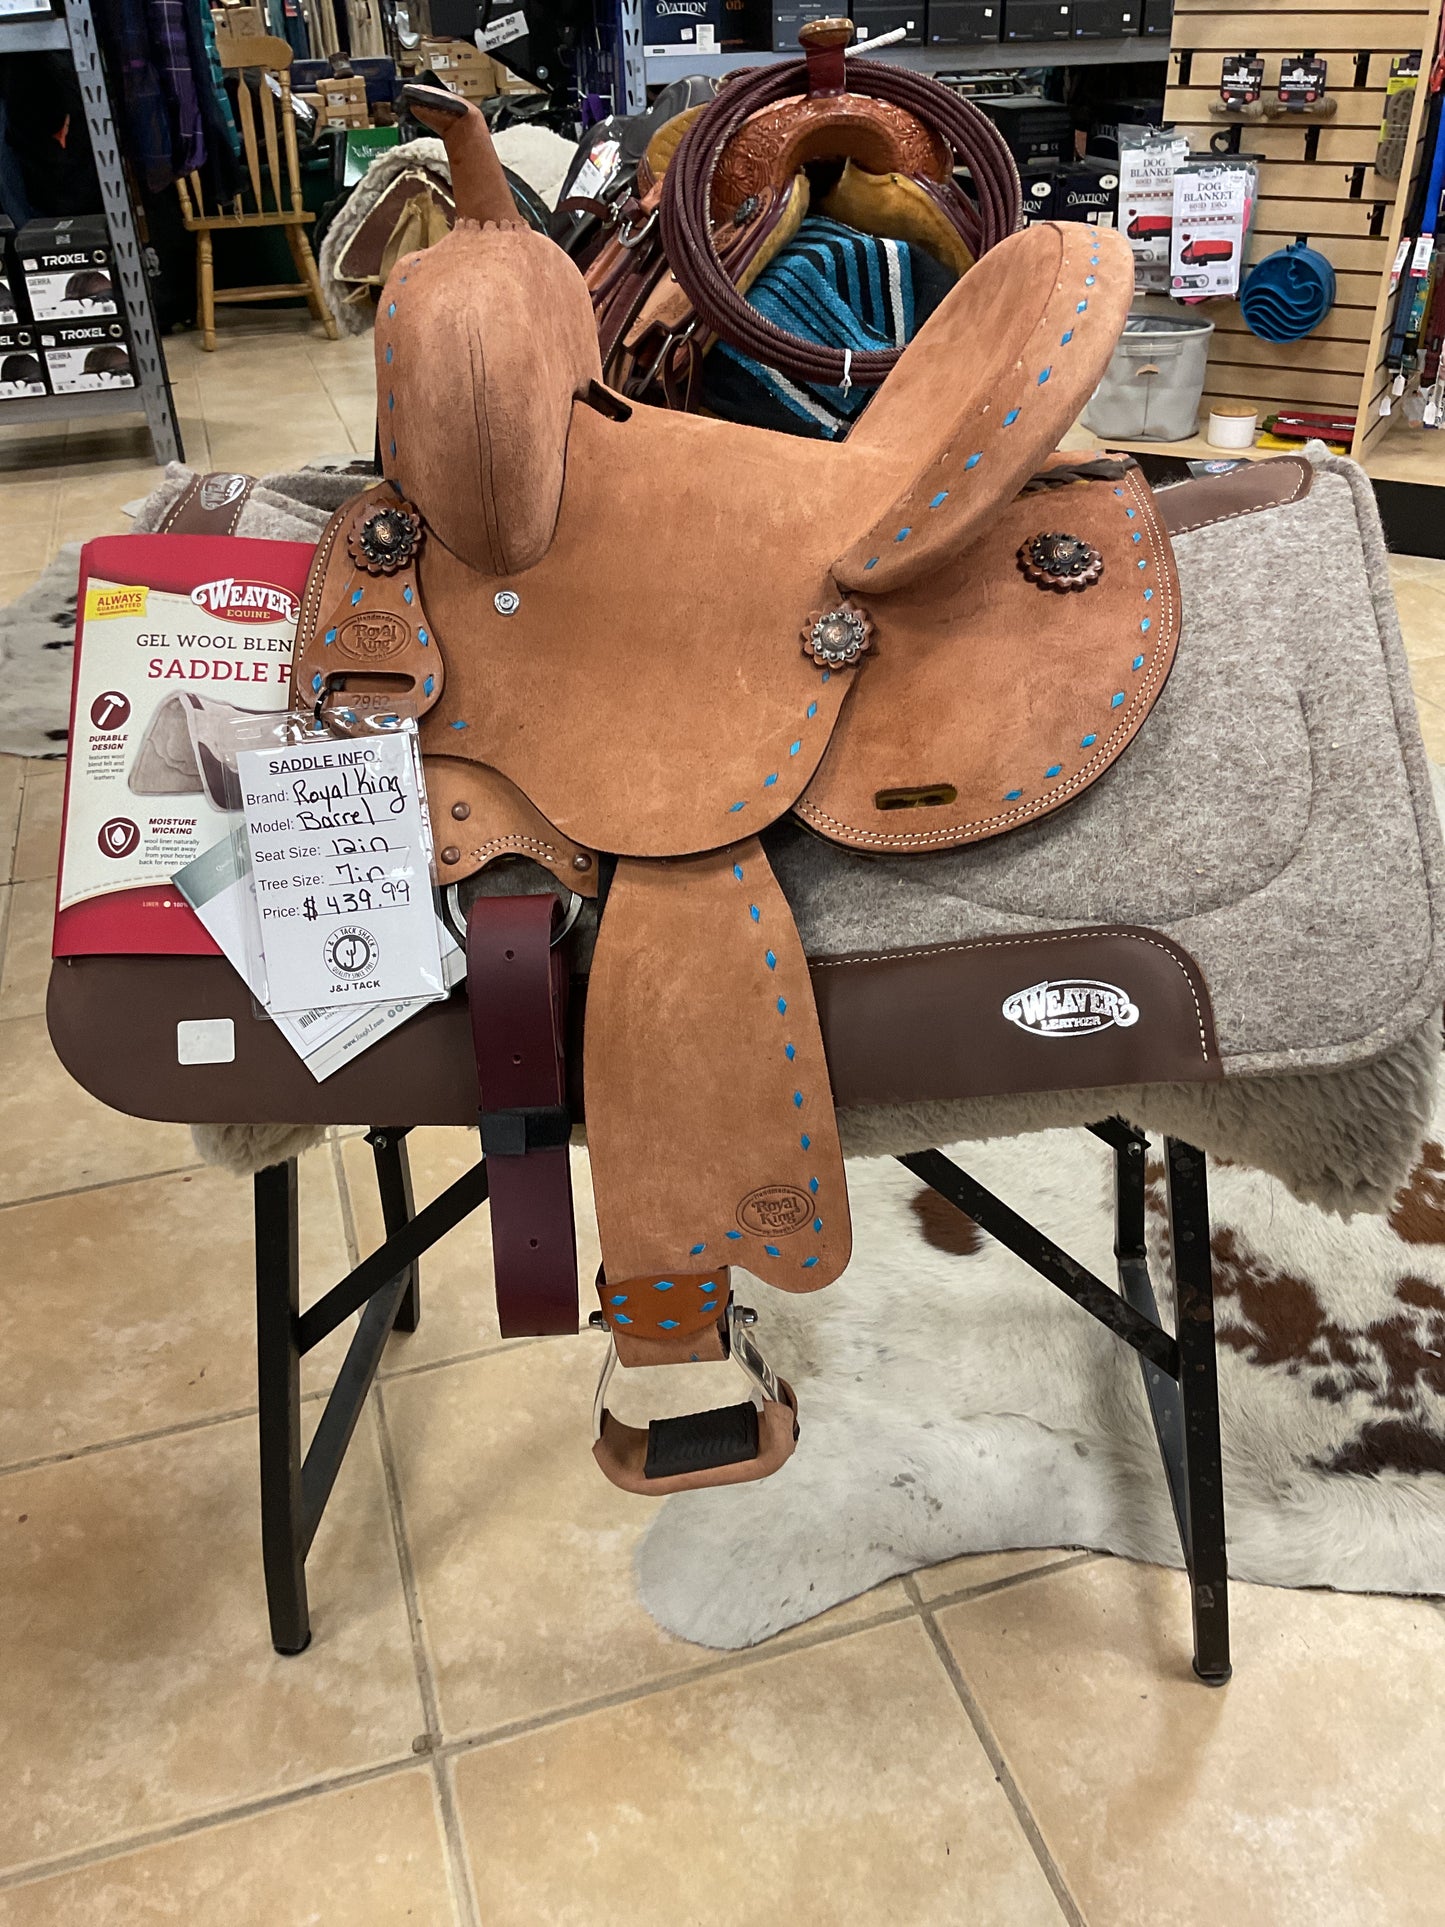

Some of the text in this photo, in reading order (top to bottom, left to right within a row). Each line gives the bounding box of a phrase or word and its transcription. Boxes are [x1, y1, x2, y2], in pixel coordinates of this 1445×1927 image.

[656, 0, 708, 14] OVATION
[485, 36, 500, 47] NOT
[1143, 158, 1166, 168] DOG
[1197, 182, 1222, 192] DOG
[1066, 190, 1110, 204] OVATION
[1183, 190, 1234, 202] BLANKET
[41, 253, 89, 267] TROXEL
[59, 326, 106, 340] TROXEL
[47, 352, 72, 361] SIERRA
[97, 593, 142, 606] ALWAYS
[190, 578, 300, 625] WEAVER
[96, 602, 142, 612] GUARANTEED
[226, 609, 271, 620] EQUINE
[352, 624, 397, 641] Royal
[136, 634, 294, 652] GEL WOOL BLEN
[355, 637, 392, 653] King
[147, 658, 269, 683] SADDLE
[89, 734, 129, 743] DURABLE
[91, 743, 124, 751] DESIGN
[268, 754, 334, 774] SADDLE
[246, 767, 408, 814] Brand: Royal King
[148, 818, 198, 826] MOISTURE
[250, 797, 376, 834] Model: Barrel
[152, 827, 193, 835] WICKING
[173, 838, 200, 846] naturally
[255, 836, 389, 863] Seat Size: 12in
[258, 863, 385, 891] Tree Size: 7in
[263, 905, 300, 919] Price:
[340, 927, 357, 936] TACK
[357, 929, 376, 948] SHACK
[331, 966, 351, 979] QUALITY
[351, 969, 366, 979] SINCE
[329, 980, 381, 993] J&J TACK
[1002, 980, 1140, 1027] WEAVER
[1040, 1015, 1102, 1031] LEATHER
[751, 1197, 801, 1214] Royal
[759, 1210, 797, 1227] King
